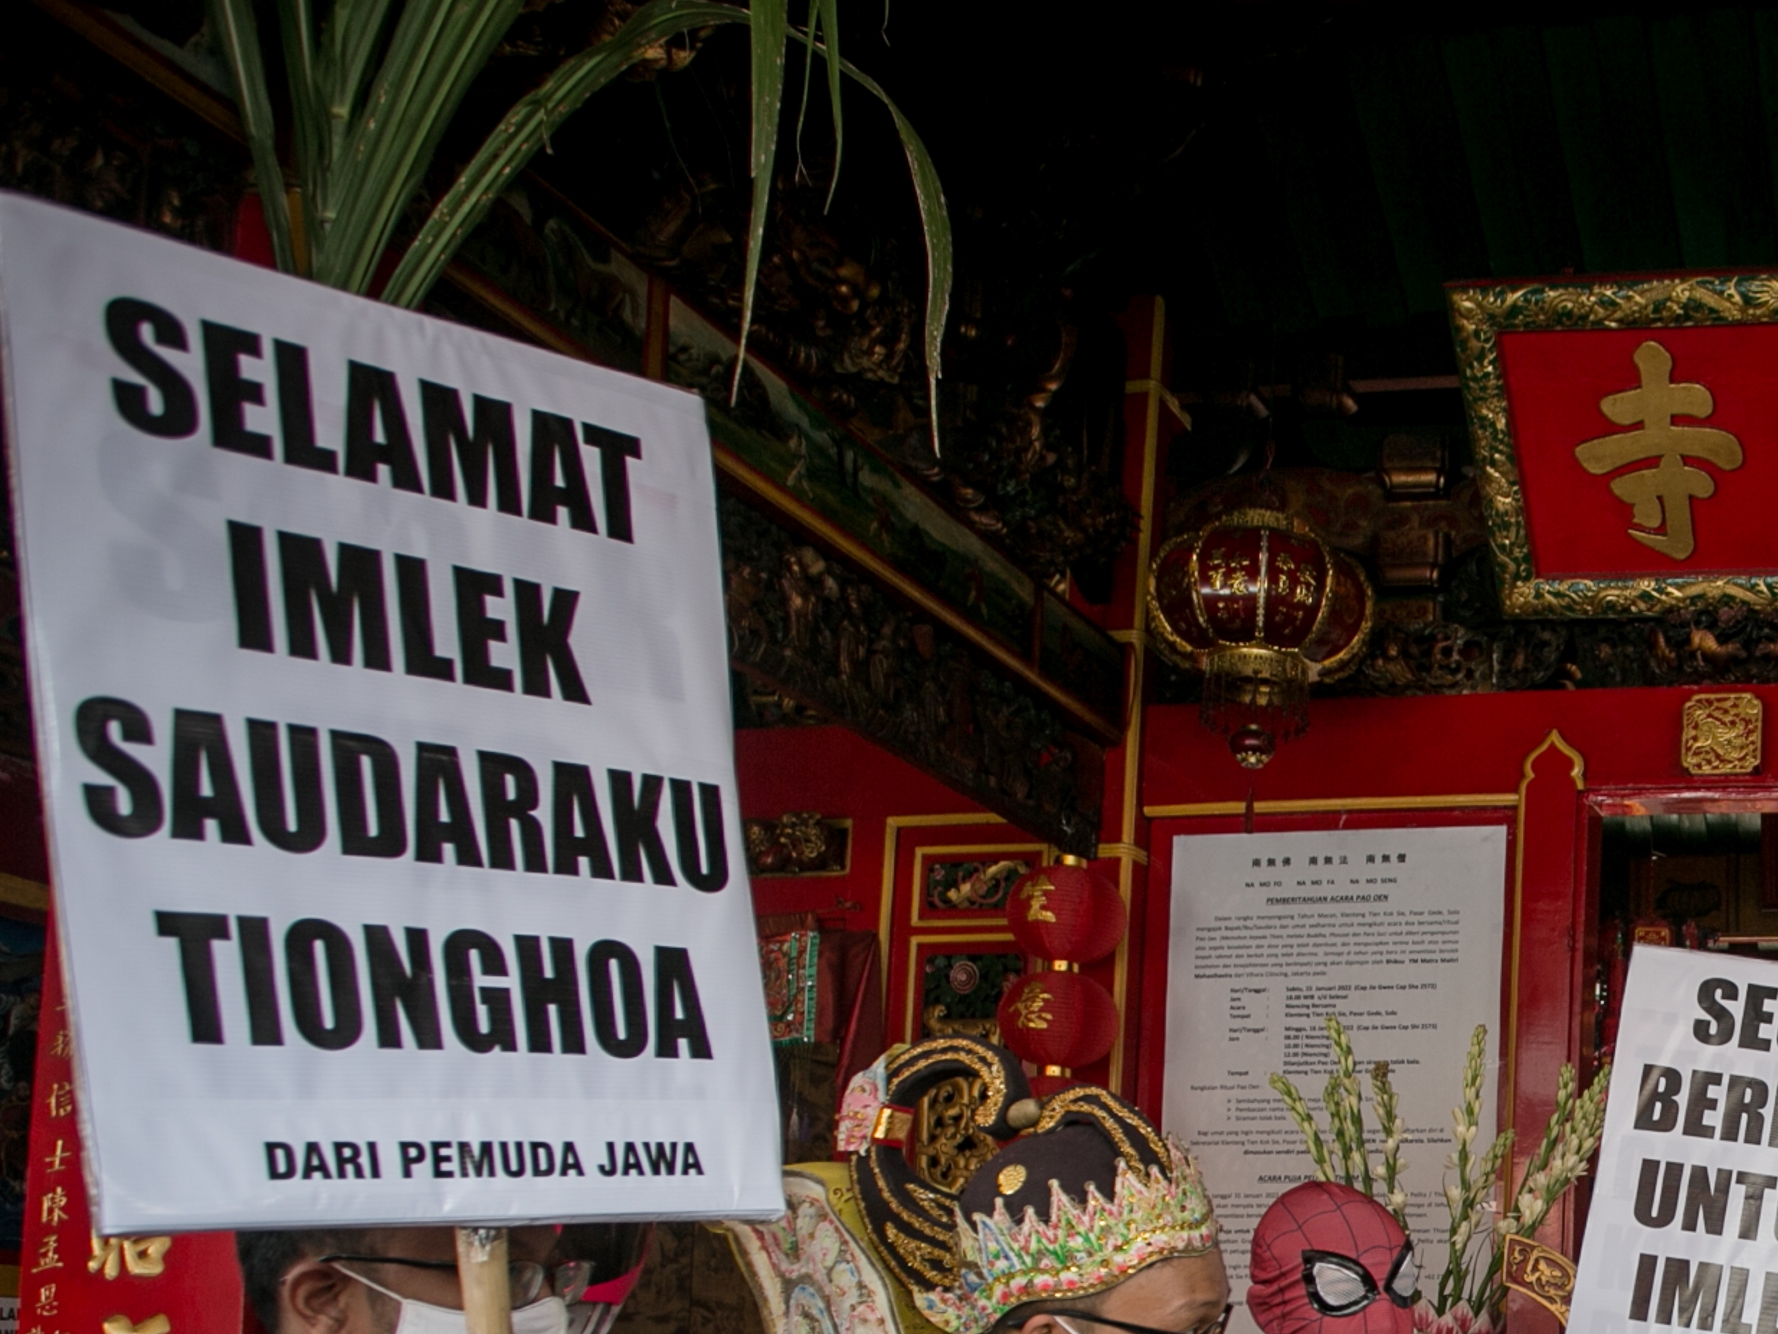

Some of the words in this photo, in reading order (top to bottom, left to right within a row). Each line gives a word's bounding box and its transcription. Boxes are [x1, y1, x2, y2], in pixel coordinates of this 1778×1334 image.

[104, 296, 643, 545] SELAMAT
[226, 519, 593, 706] IMLEK
[75, 695, 731, 894] SAUDARAKU
[153, 910, 714, 1061] TIONGHOA
[264, 1140, 382, 1180] DARI
[400, 1141, 585, 1179] PEMUDA
[597, 1141, 705, 1177] JAWA
